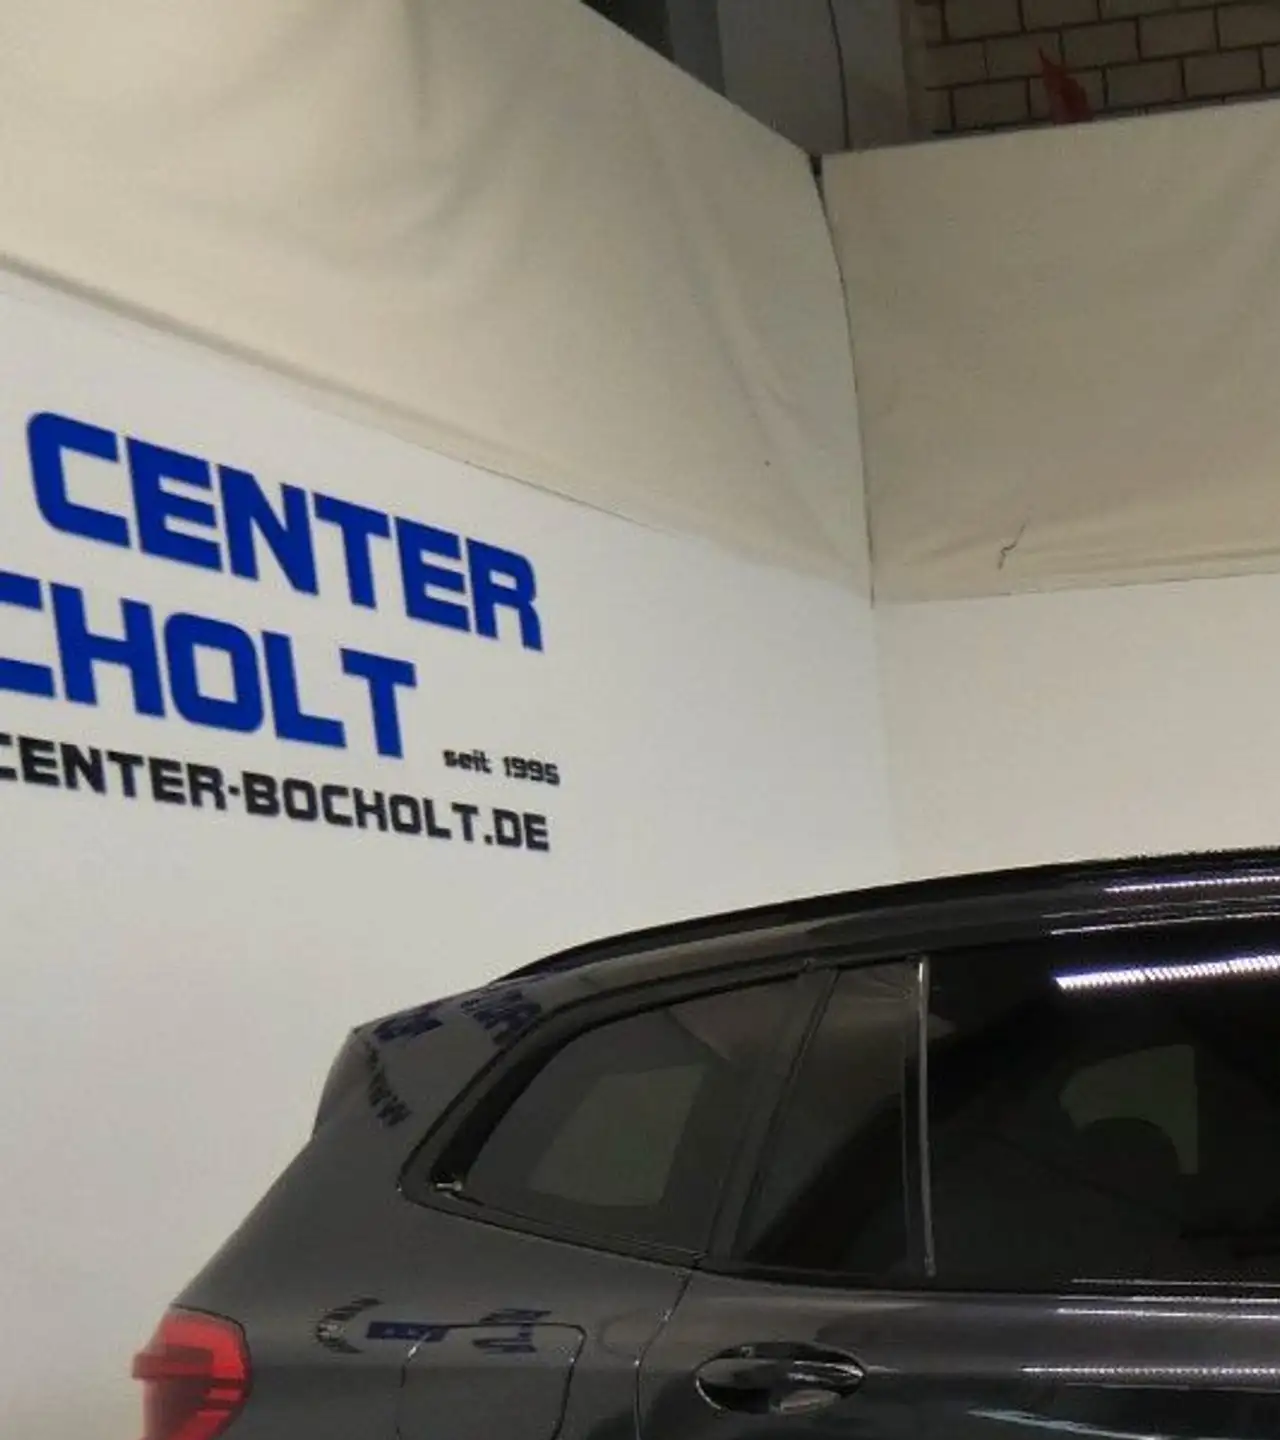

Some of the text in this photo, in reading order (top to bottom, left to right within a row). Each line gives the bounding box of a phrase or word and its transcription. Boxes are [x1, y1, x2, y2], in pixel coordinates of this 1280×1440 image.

[26, 411, 543, 652] CENTER
[443, 748, 561, 787] seit 1995
